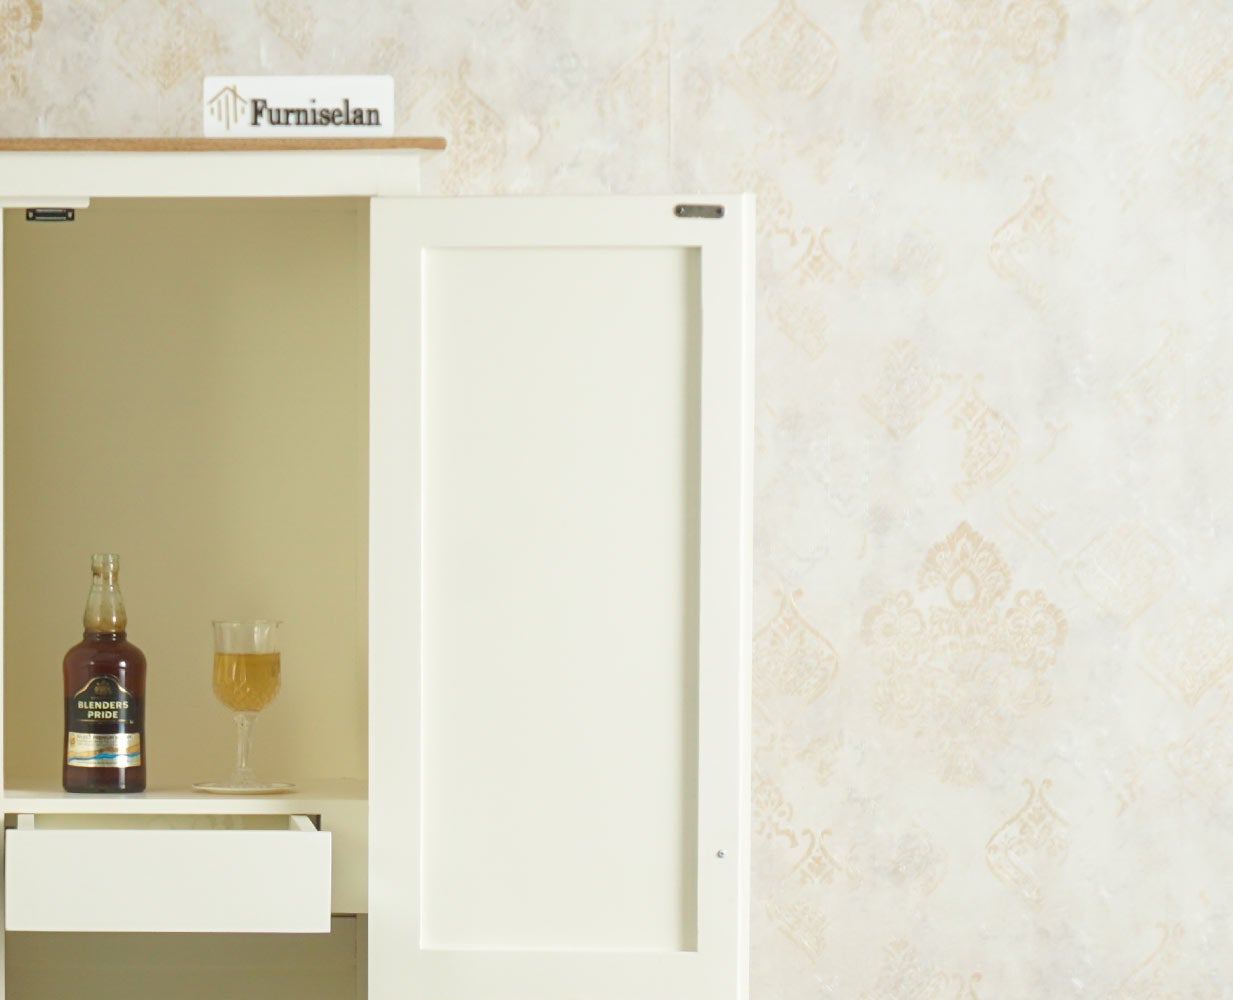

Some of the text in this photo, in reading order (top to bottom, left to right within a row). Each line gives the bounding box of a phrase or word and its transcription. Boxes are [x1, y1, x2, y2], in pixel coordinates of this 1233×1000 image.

[250, 98, 381, 126] Furniselan
[77, 701, 129, 709] BLENDERS
[87, 711, 119, 719] PRIDE
